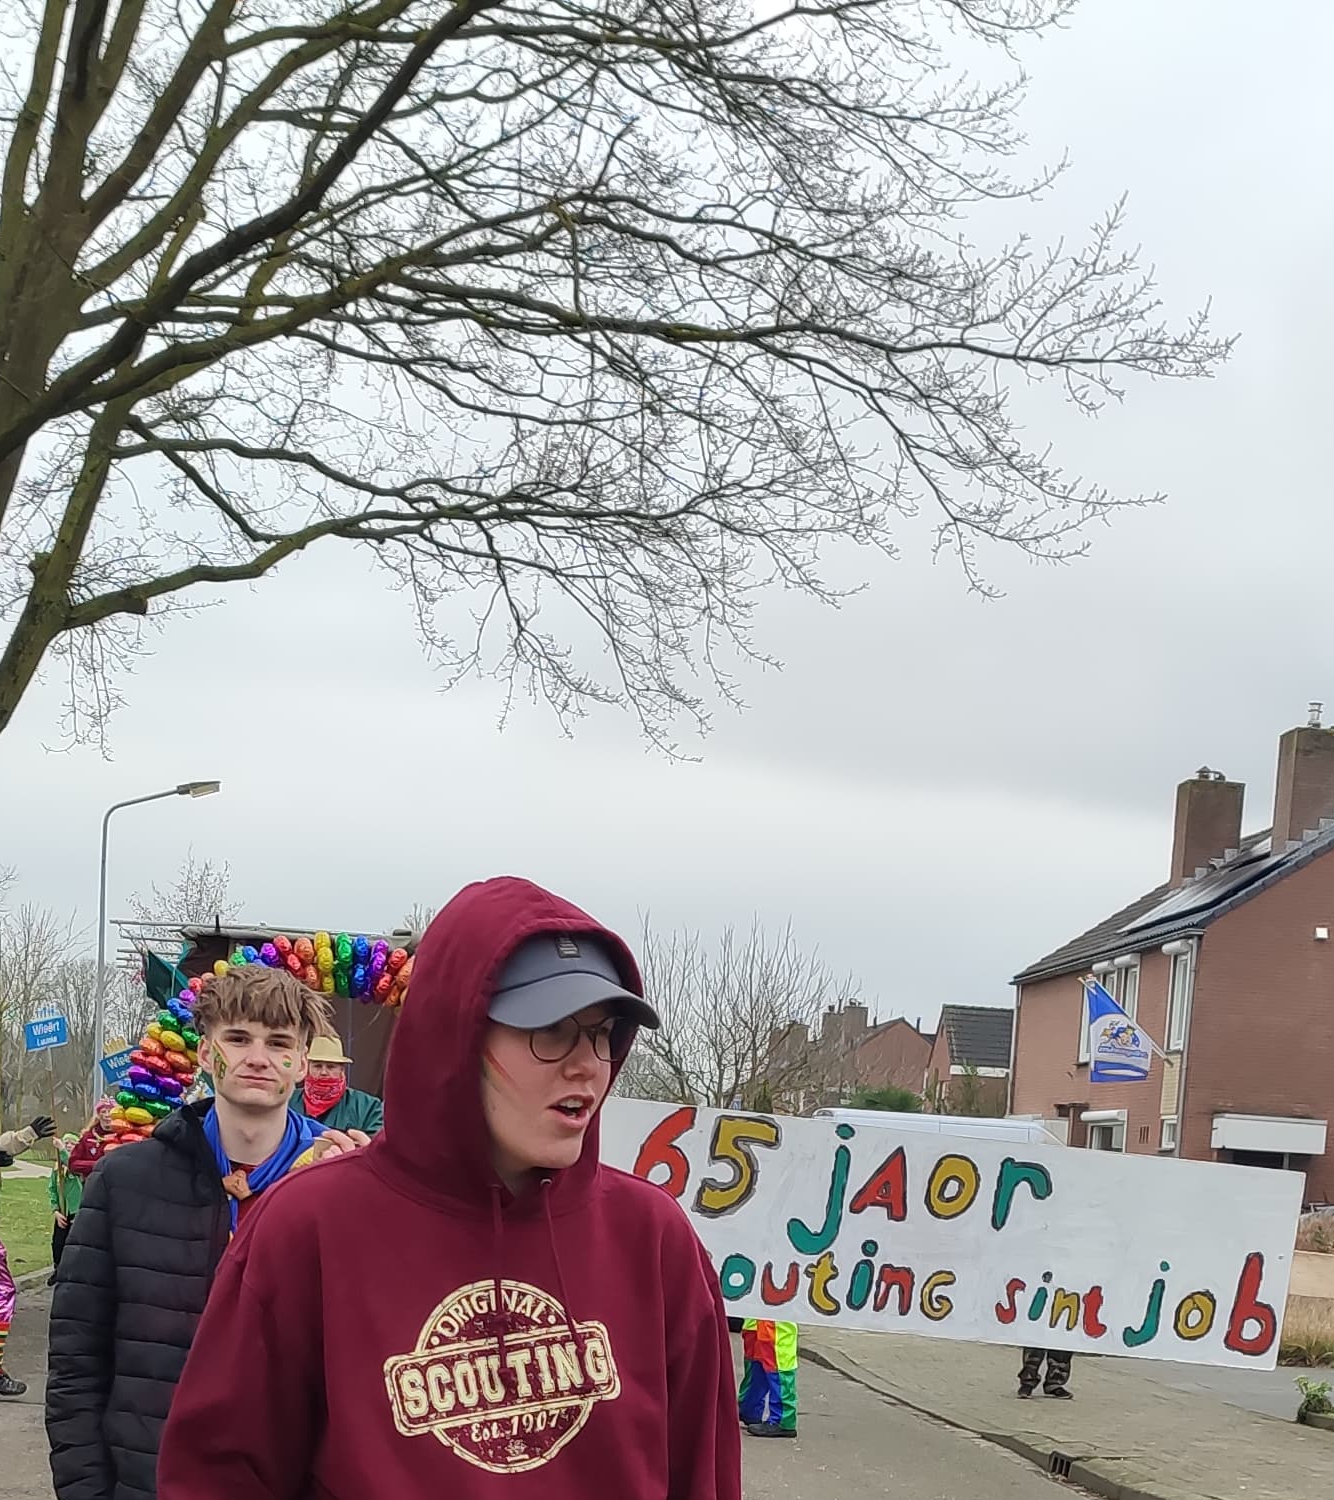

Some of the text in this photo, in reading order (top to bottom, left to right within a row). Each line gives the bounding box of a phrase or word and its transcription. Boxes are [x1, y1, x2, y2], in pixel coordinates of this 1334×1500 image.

[633, 1106, 782, 1217] 65
[436, 1289, 544, 1338] ORIGINAL
[709, 1239, 1279, 1356] outinG sint job
[400, 1338, 611, 1419] SCOUTING
[511, 1408, 560, 1437] 1907
